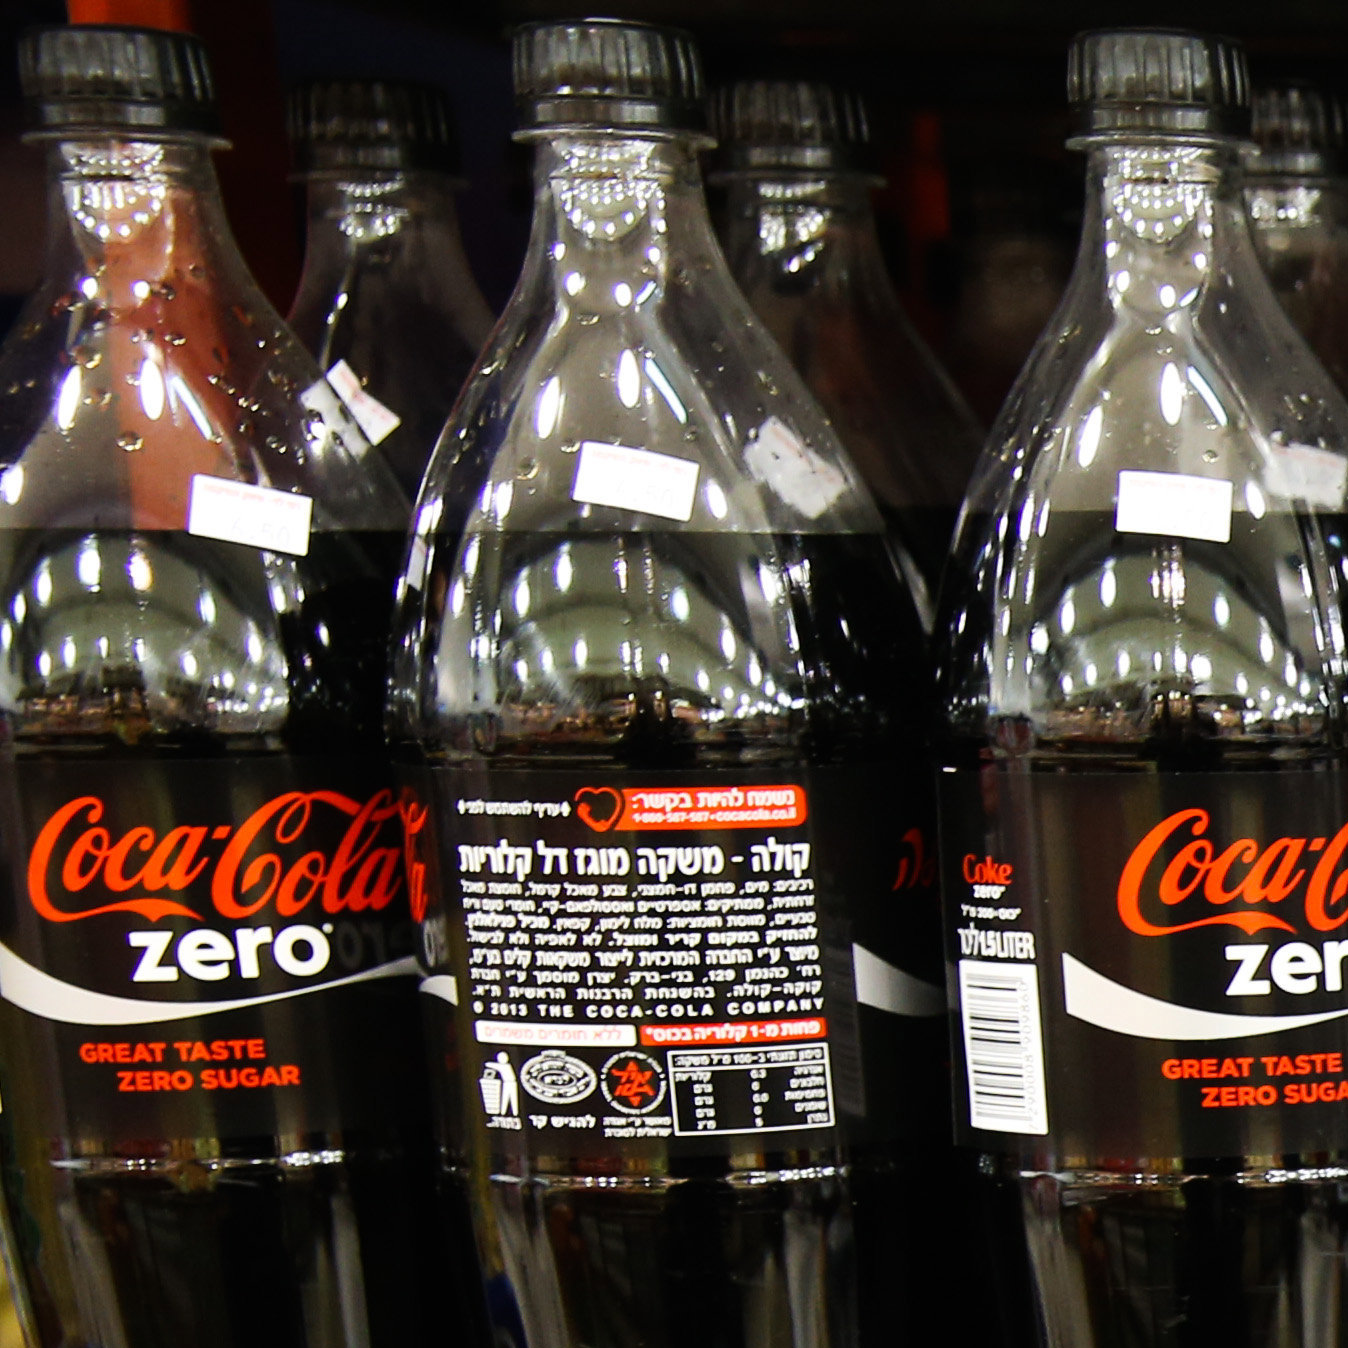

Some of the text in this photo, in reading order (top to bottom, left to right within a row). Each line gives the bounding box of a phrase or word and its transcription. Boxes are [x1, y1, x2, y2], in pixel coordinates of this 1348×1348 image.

[27, 790, 402, 922] Coca-Cola
[458, 837, 812, 882] קולה משקה מוגז דל קלוריות
[964, 855, 1012, 885] Coke
[127, 923, 331, 983] zero
[538, 1004, 573, 1017] THE
[586, 1004, 713, 1018] COCA-COLA
[727, 998, 823, 1015] COMPANY
[79, 1038, 266, 1064] GREAT TASTE
[117, 1064, 301, 1092] ZERO SUGAR
[1162, 1053, 1343, 1080] GREAT TASTE
[1201, 1085, 1276, 1108] ZERO
